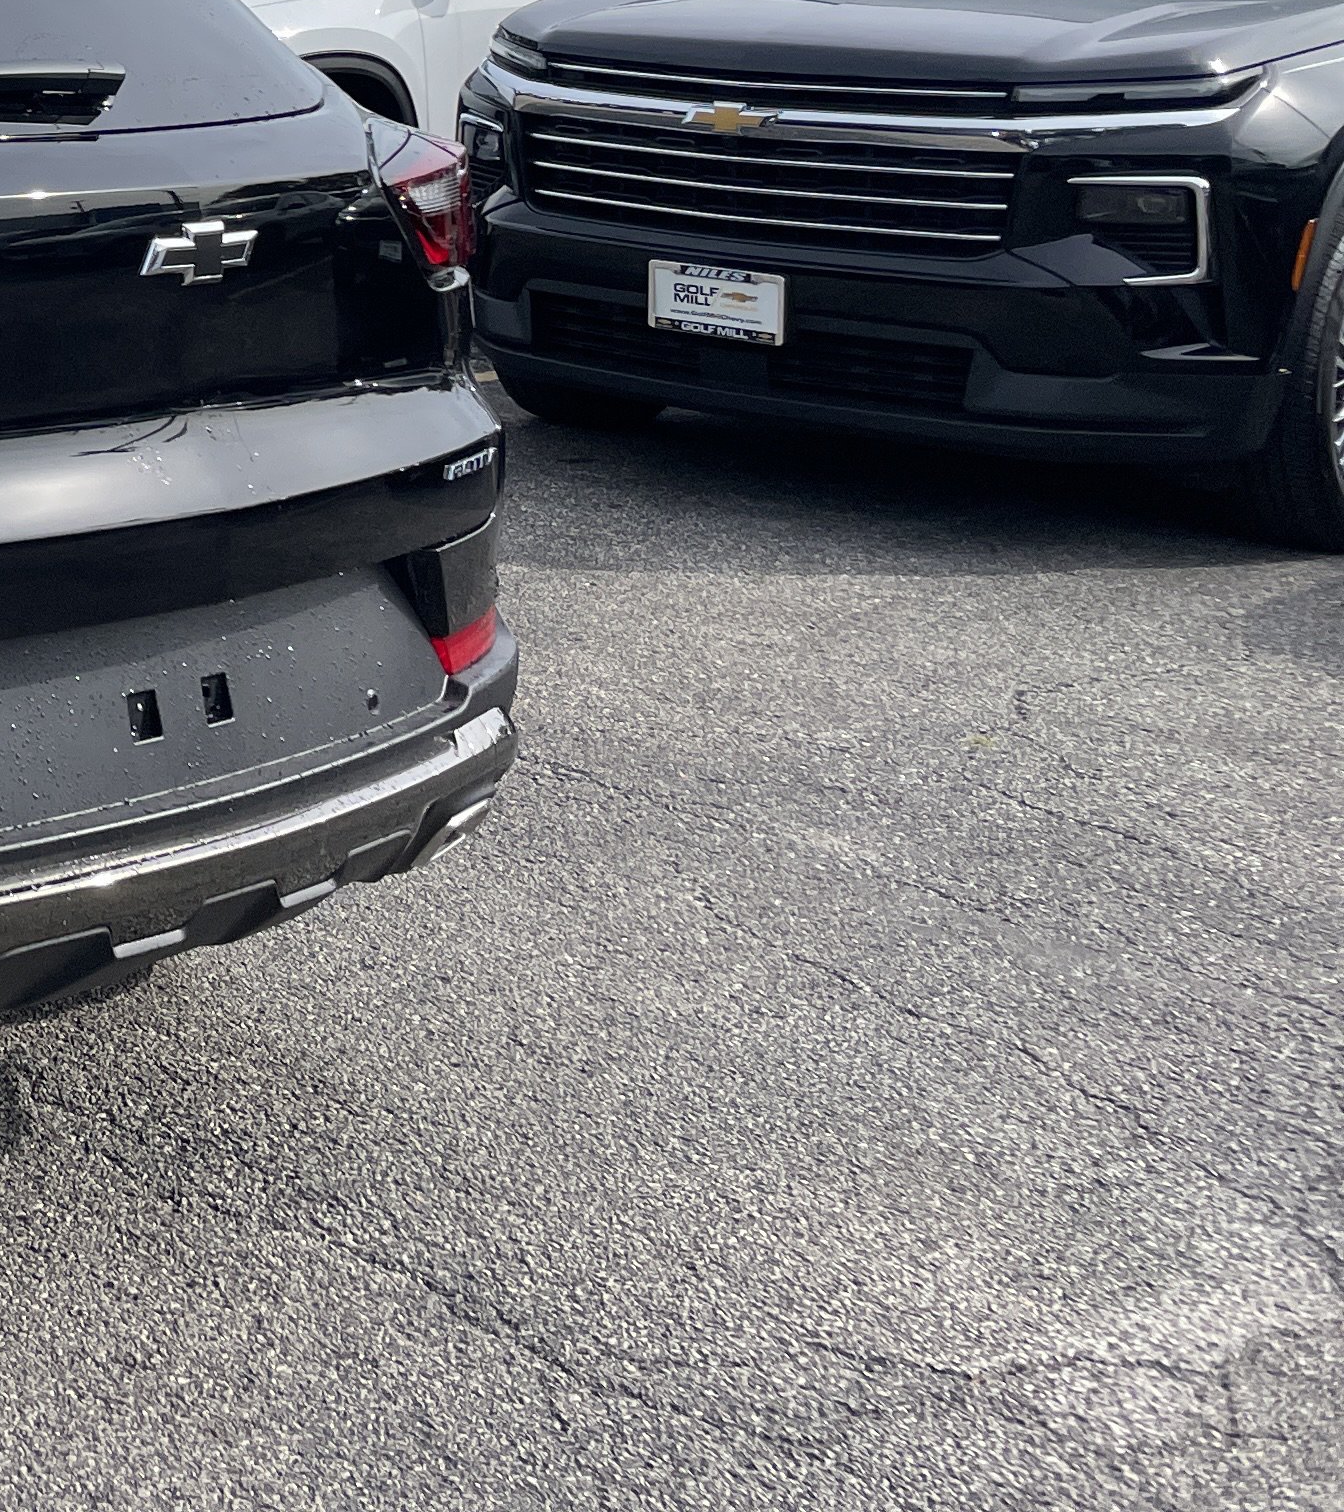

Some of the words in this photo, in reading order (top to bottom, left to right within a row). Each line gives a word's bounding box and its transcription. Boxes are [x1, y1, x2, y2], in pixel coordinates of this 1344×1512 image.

[685, 266, 747, 282] NILES
[673, 283, 719, 297] GOLF
[673, 293, 711, 306] MILL
[681, 321, 716, 334] GOLF
[717, 327, 749, 339] MILL
